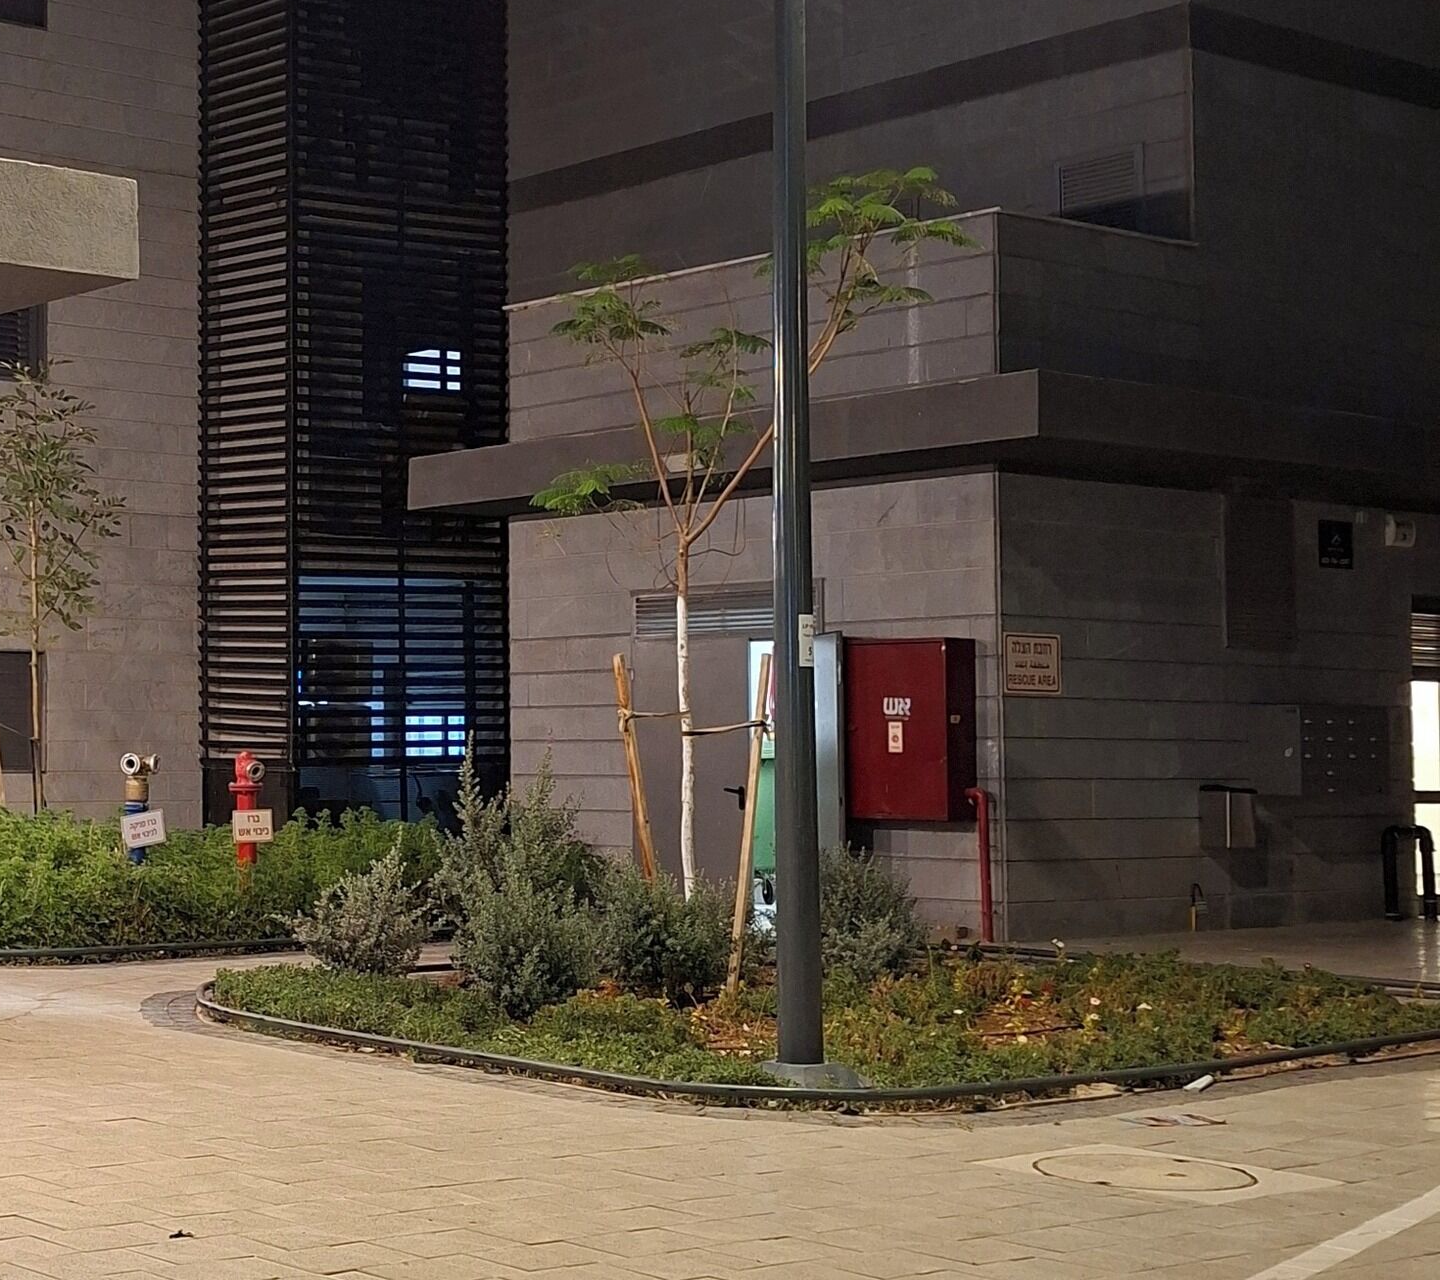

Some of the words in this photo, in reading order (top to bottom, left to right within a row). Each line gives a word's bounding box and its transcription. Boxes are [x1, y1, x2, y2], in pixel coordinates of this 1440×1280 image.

[1008, 673, 1036, 686] RESCUE
[1038, 674, 1056, 687] AREA
[882, 696, 912, 716] אש
[247, 815, 260, 823] ברז
[238, 828, 251, 837] אש
